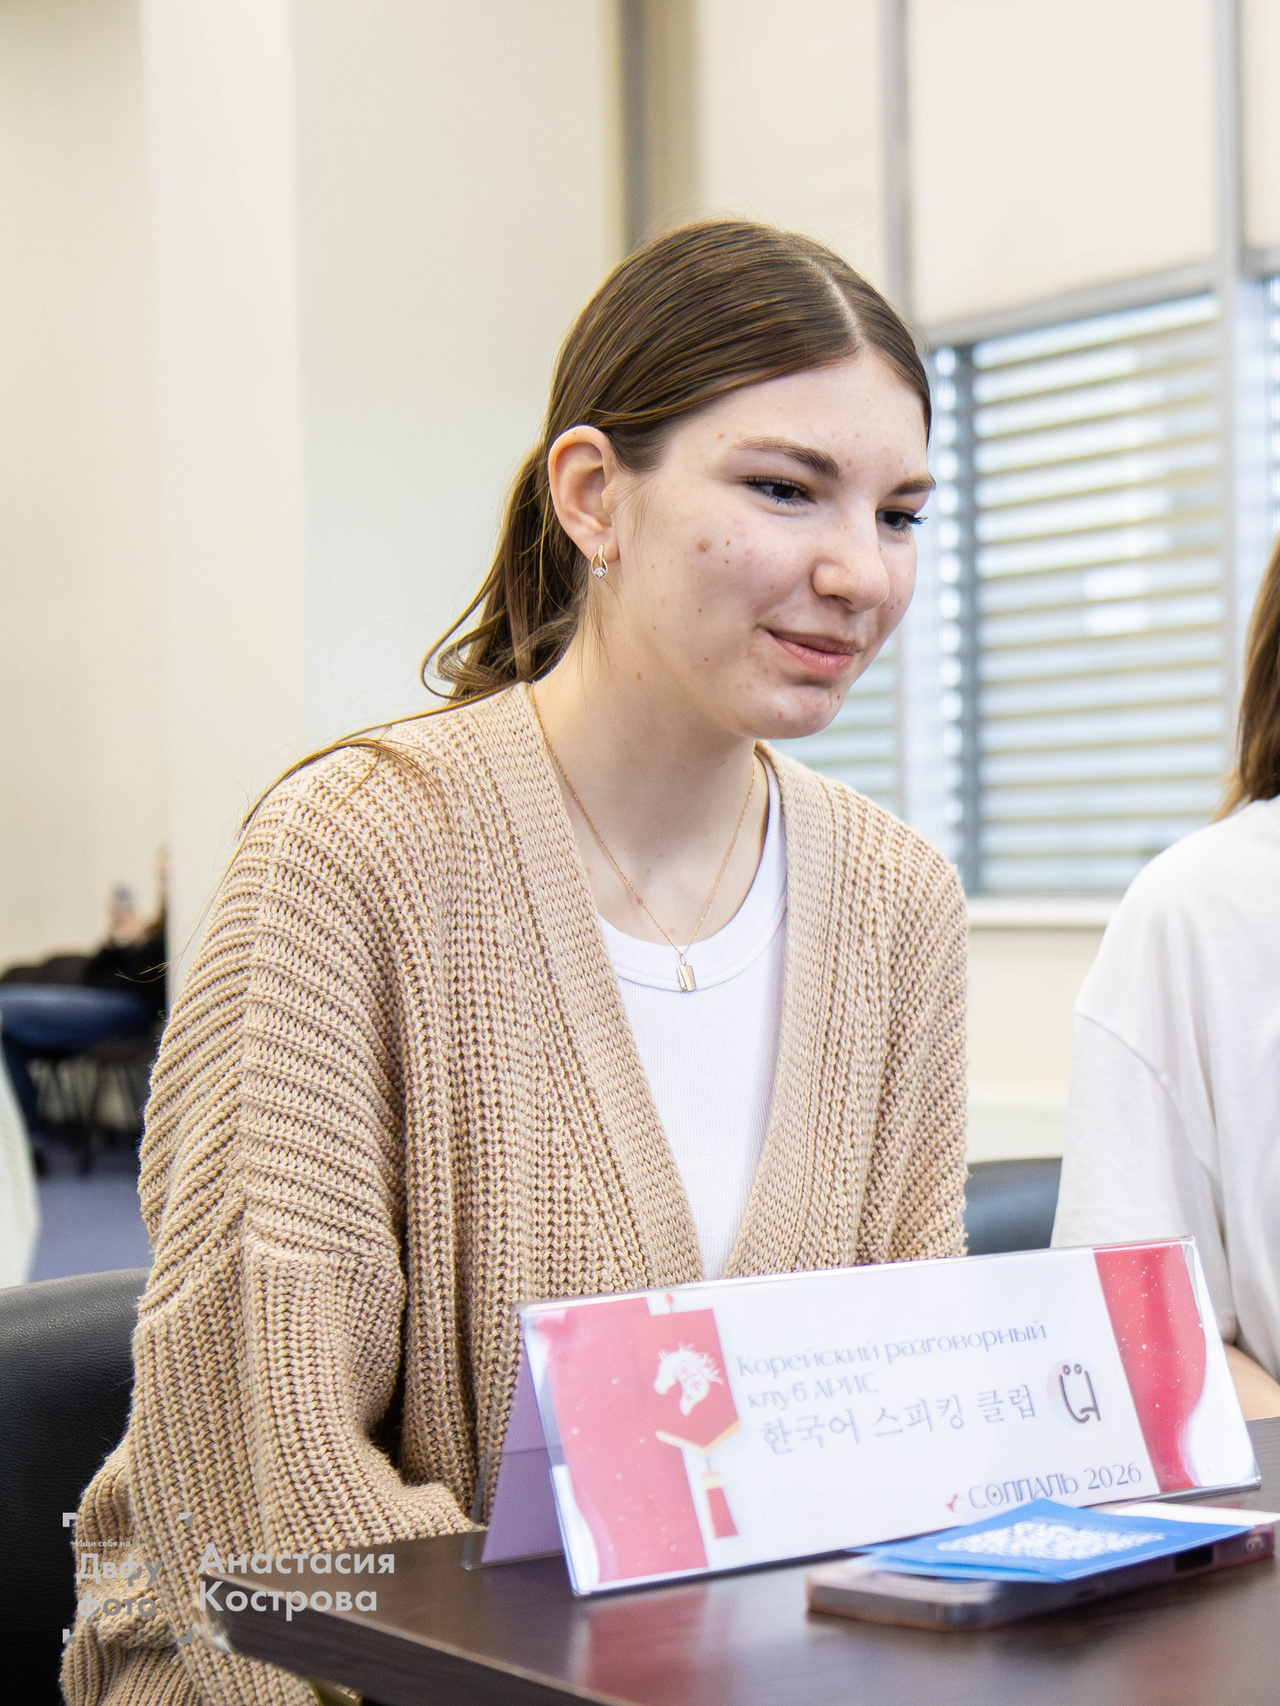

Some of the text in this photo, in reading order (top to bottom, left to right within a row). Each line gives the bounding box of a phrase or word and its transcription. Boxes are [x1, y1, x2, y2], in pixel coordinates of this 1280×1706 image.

[736, 1319, 1047, 1379] Корейский разговорный
[747, 1371, 879, 1412] клуб АРИС
[759, 1384, 1036, 1456] 한국어 스피킹 클럽
[1083, 1461, 1142, 1491] 2026
